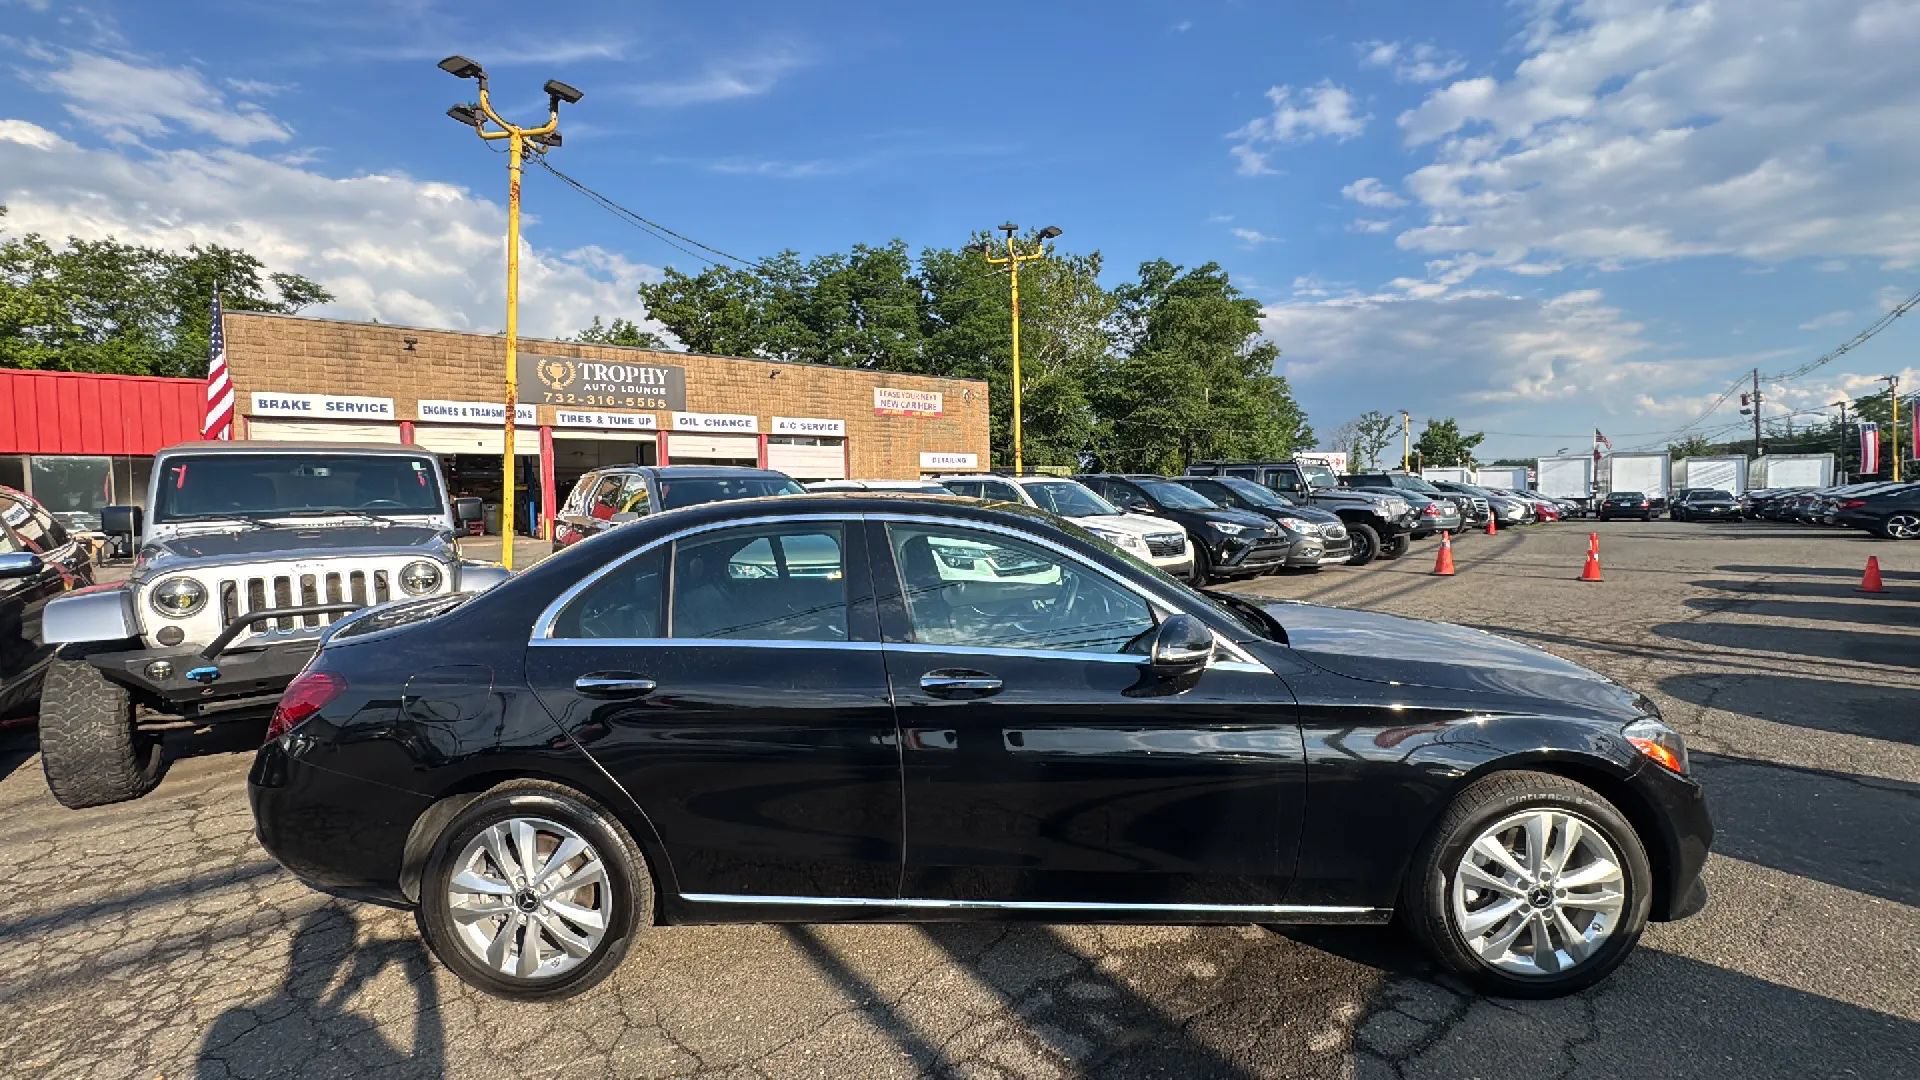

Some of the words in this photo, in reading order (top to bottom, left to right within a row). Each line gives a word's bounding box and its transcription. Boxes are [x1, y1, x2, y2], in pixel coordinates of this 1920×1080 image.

[577, 362, 669, 385] TROPHY
[583, 383, 616, 393] AUTO
[621, 385, 667, 395] LOUNGE
[879, 389, 901, 399] LEASE
[258, 398, 312, 411] BRAKE
[325, 401, 389, 414] SERVICE
[880, 399, 899, 408] NEW
[900, 401, 917, 409] CAR
[917, 402, 937, 411] HERE
[423, 405, 459, 417] ENGINES
[462, 407, 468, 417] &
[470, 407, 533, 420] TRANSMIIONS
[559, 413, 593, 424] TIRES
[597, 415, 604, 425] &
[607, 415, 635, 425] TUNE
[638, 417, 652, 426] UP
[679, 417, 700, 427] OIL
[704, 417, 753, 428] CHANGE
[779, 421, 797, 430] A/C
[801, 422, 839, 431] SERVICE
